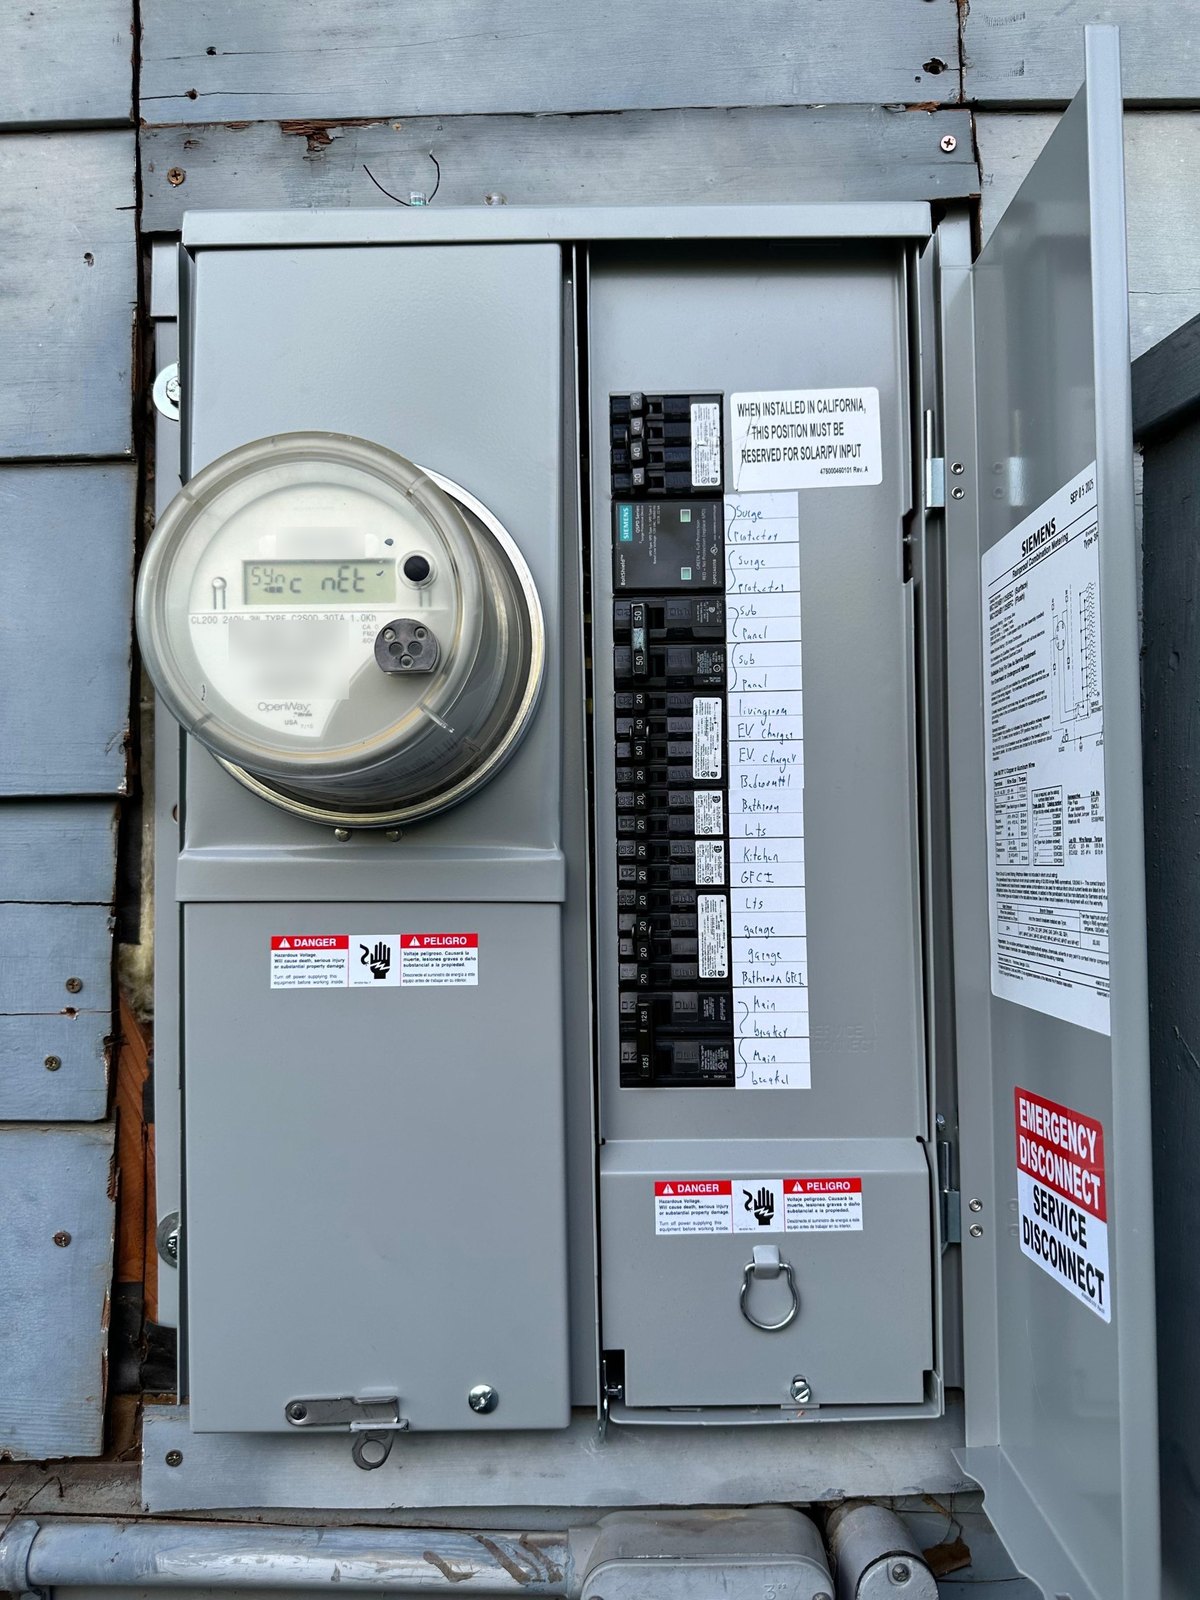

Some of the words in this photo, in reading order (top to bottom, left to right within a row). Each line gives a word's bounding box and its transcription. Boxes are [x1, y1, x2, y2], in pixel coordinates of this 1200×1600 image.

[737, 403, 761, 417] WHEN
[762, 401, 806, 416] INSTALLED
[807, 400, 815, 414] IN
[817, 398, 866, 414] CALIFORNIA,
[634, 421, 640, 431] 40
[752, 425, 769, 440] THIS
[771, 424, 808, 439] POSITION
[810, 422, 831, 437] MUST
[833, 422, 844, 436] BE
[634, 447, 641, 457] 40
[741, 448, 781, 463] RESERVED
[783, 446, 798, 461] FOR
[800, 444, 838, 460] SOLAR/PV
[839, 443, 861, 458] INPUT
[634, 473, 642, 482] 20
[736, 505, 762, 523] Surge
[1021, 517, 1056, 558] SIEMENS
[1028, 545, 1051, 566] Combination
[1051, 532, 1068, 550] Metering
[738, 555, 765, 571] Surge
[634, 610, 642, 621] 50
[740, 604, 756, 616] Sub
[743, 625, 768, 640] Panel
[635, 655, 644, 666] 50
[739, 653, 755, 665] Sub
[636, 694, 643, 704] 20
[636, 770, 644, 780] 20
[637, 819, 644, 830] 20
[638, 845, 646, 856] 20
[743, 846, 778, 863] Kitchen
[639, 870, 646, 880] 20
[740, 870, 774, 884] GFCI
[640, 895, 646, 906] 20
[640, 921, 646, 931] 20
[293, 938, 337, 947] DANGER
[423, 936, 467, 946] PELIGRO
[640, 947, 647, 958] 20
[640, 973, 647, 984] 20
[1019, 1097, 1097, 1164] EMERGENCY
[1019, 1135, 1100, 1211] DISCONNECT
[677, 1183, 720, 1193] DANGER
[806, 1181, 851, 1191] PELIGRO
[1033, 1184, 1088, 1250] SERVICE
[1022, 1214, 1104, 1305] DISCONNECT
